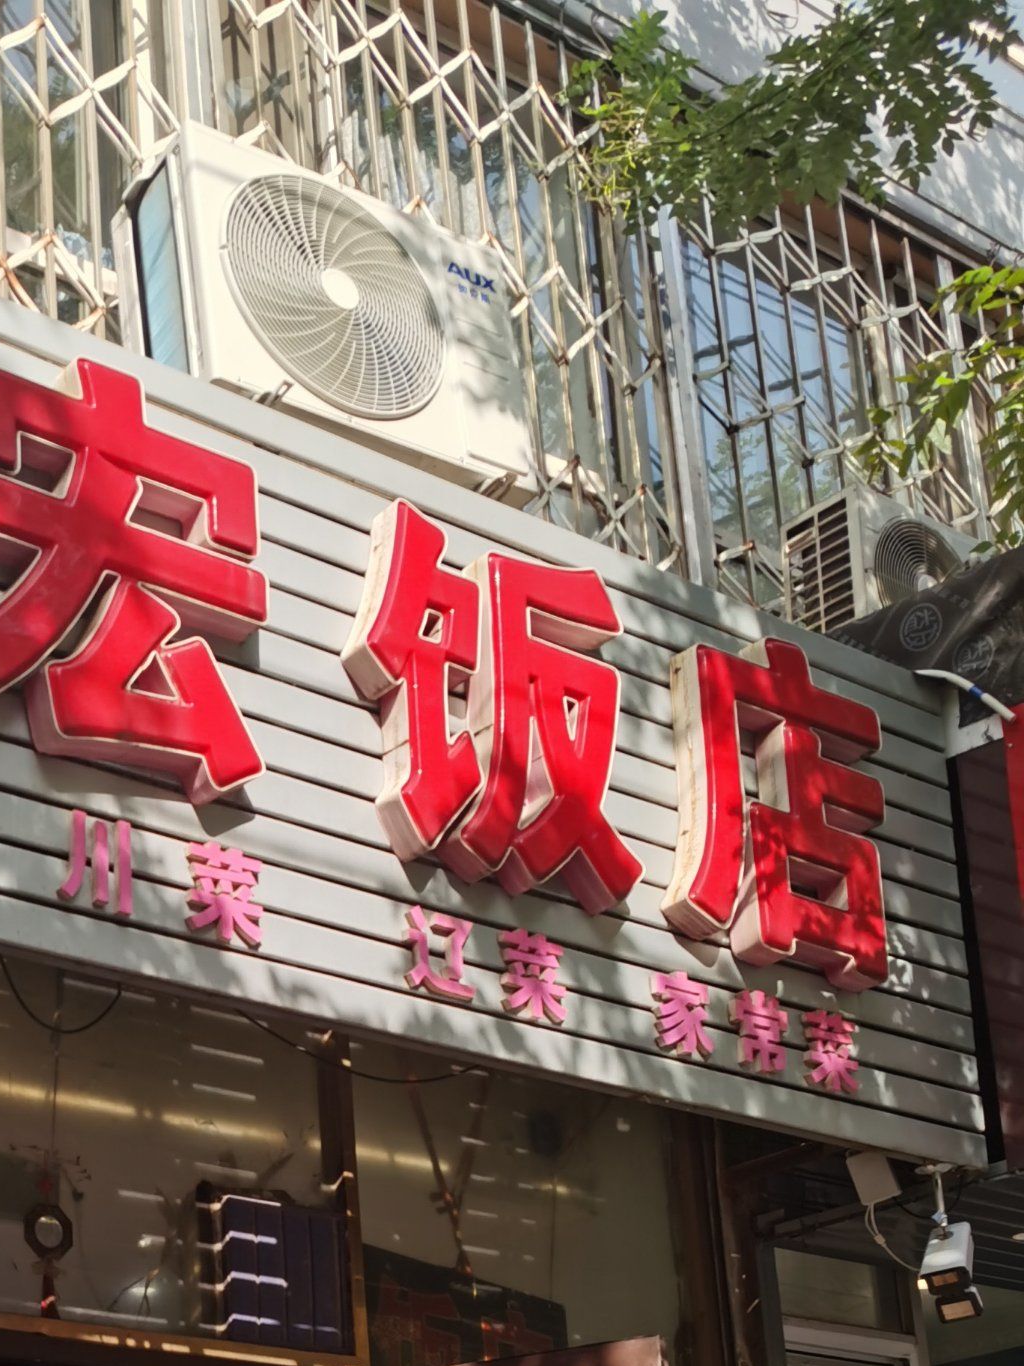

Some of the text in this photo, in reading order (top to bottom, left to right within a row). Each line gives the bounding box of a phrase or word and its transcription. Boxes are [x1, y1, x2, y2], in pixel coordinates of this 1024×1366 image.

[447, 261, 496, 294] AUX
[56, 809, 264, 948] 川菜
[402, 904, 567, 1025] 辽菜
[650, 970, 861, 1094] 家常菜
